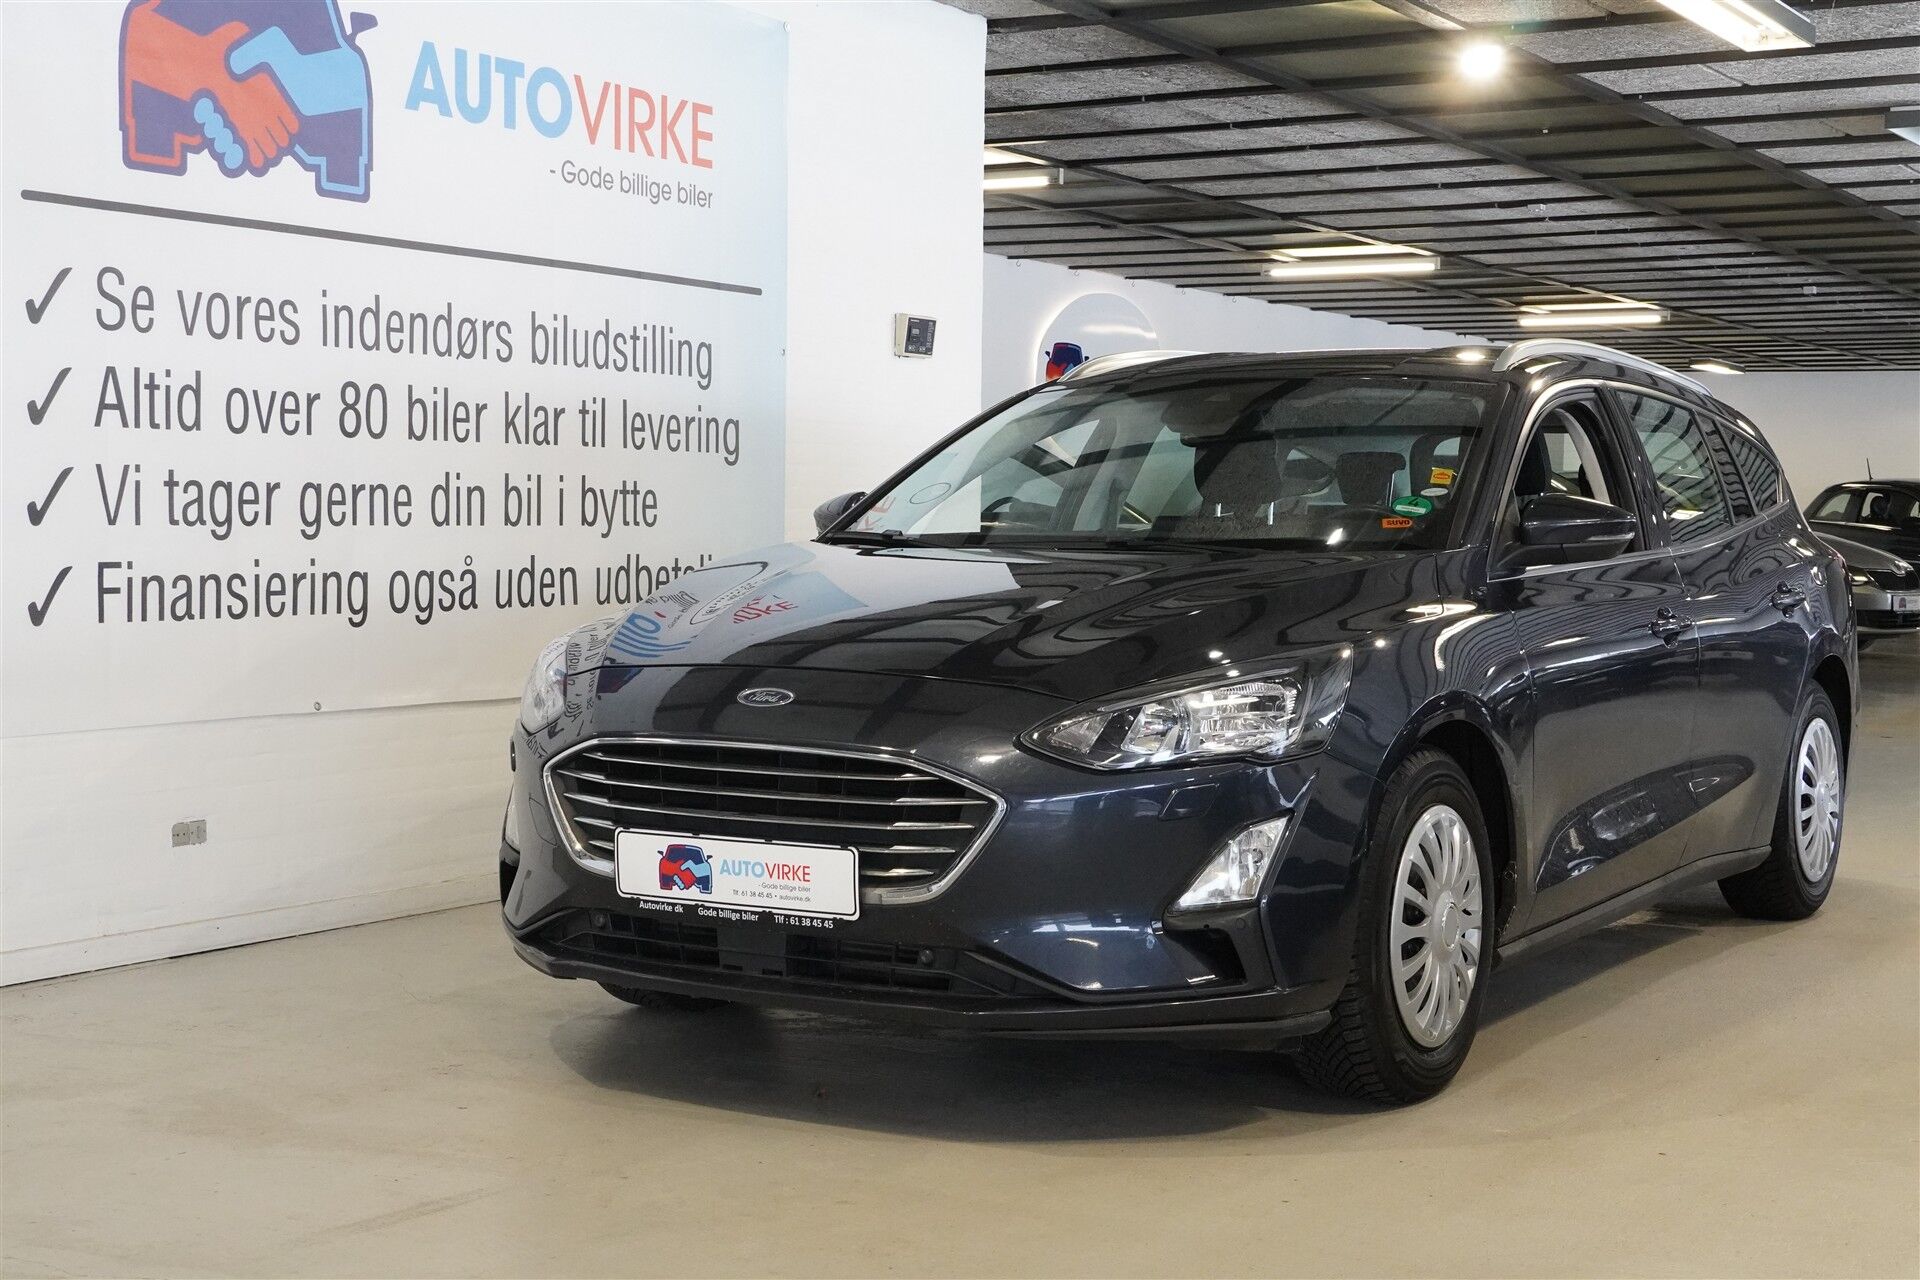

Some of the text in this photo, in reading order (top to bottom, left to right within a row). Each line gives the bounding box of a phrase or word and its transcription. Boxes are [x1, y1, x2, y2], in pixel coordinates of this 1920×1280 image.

[405, 40, 714, 169] AUTOVIRKE
[561, 160, 614, 191] Gode
[620, 170, 672, 205] billige
[677, 181, 713, 208] biler
[95, 265, 713, 391] Se vores indendørs biludstilling
[93, 365, 741, 467] Altid over 80 biler klar til levering
[95, 463, 658, 542] Vi tager gerne din bil i bytte
[97, 555, 369, 629] Finansiering
[388, 554, 480, 629] også
[495, 554, 580, 610] uden
[719, 859, 811, 882] AUTOVIRKE
[761, 882, 778, 890] Gode
[780, 884, 797, 892] billige
[639, 900, 673, 912] Autovirke
[750, 890, 757, 898] 38
[698, 907, 759, 921] Gode billige biler
[790, 916, 800, 926] 61
[801, 918, 811, 927] 38
[812, 919, 822, 928] 45
[823, 921, 834, 929] 45
